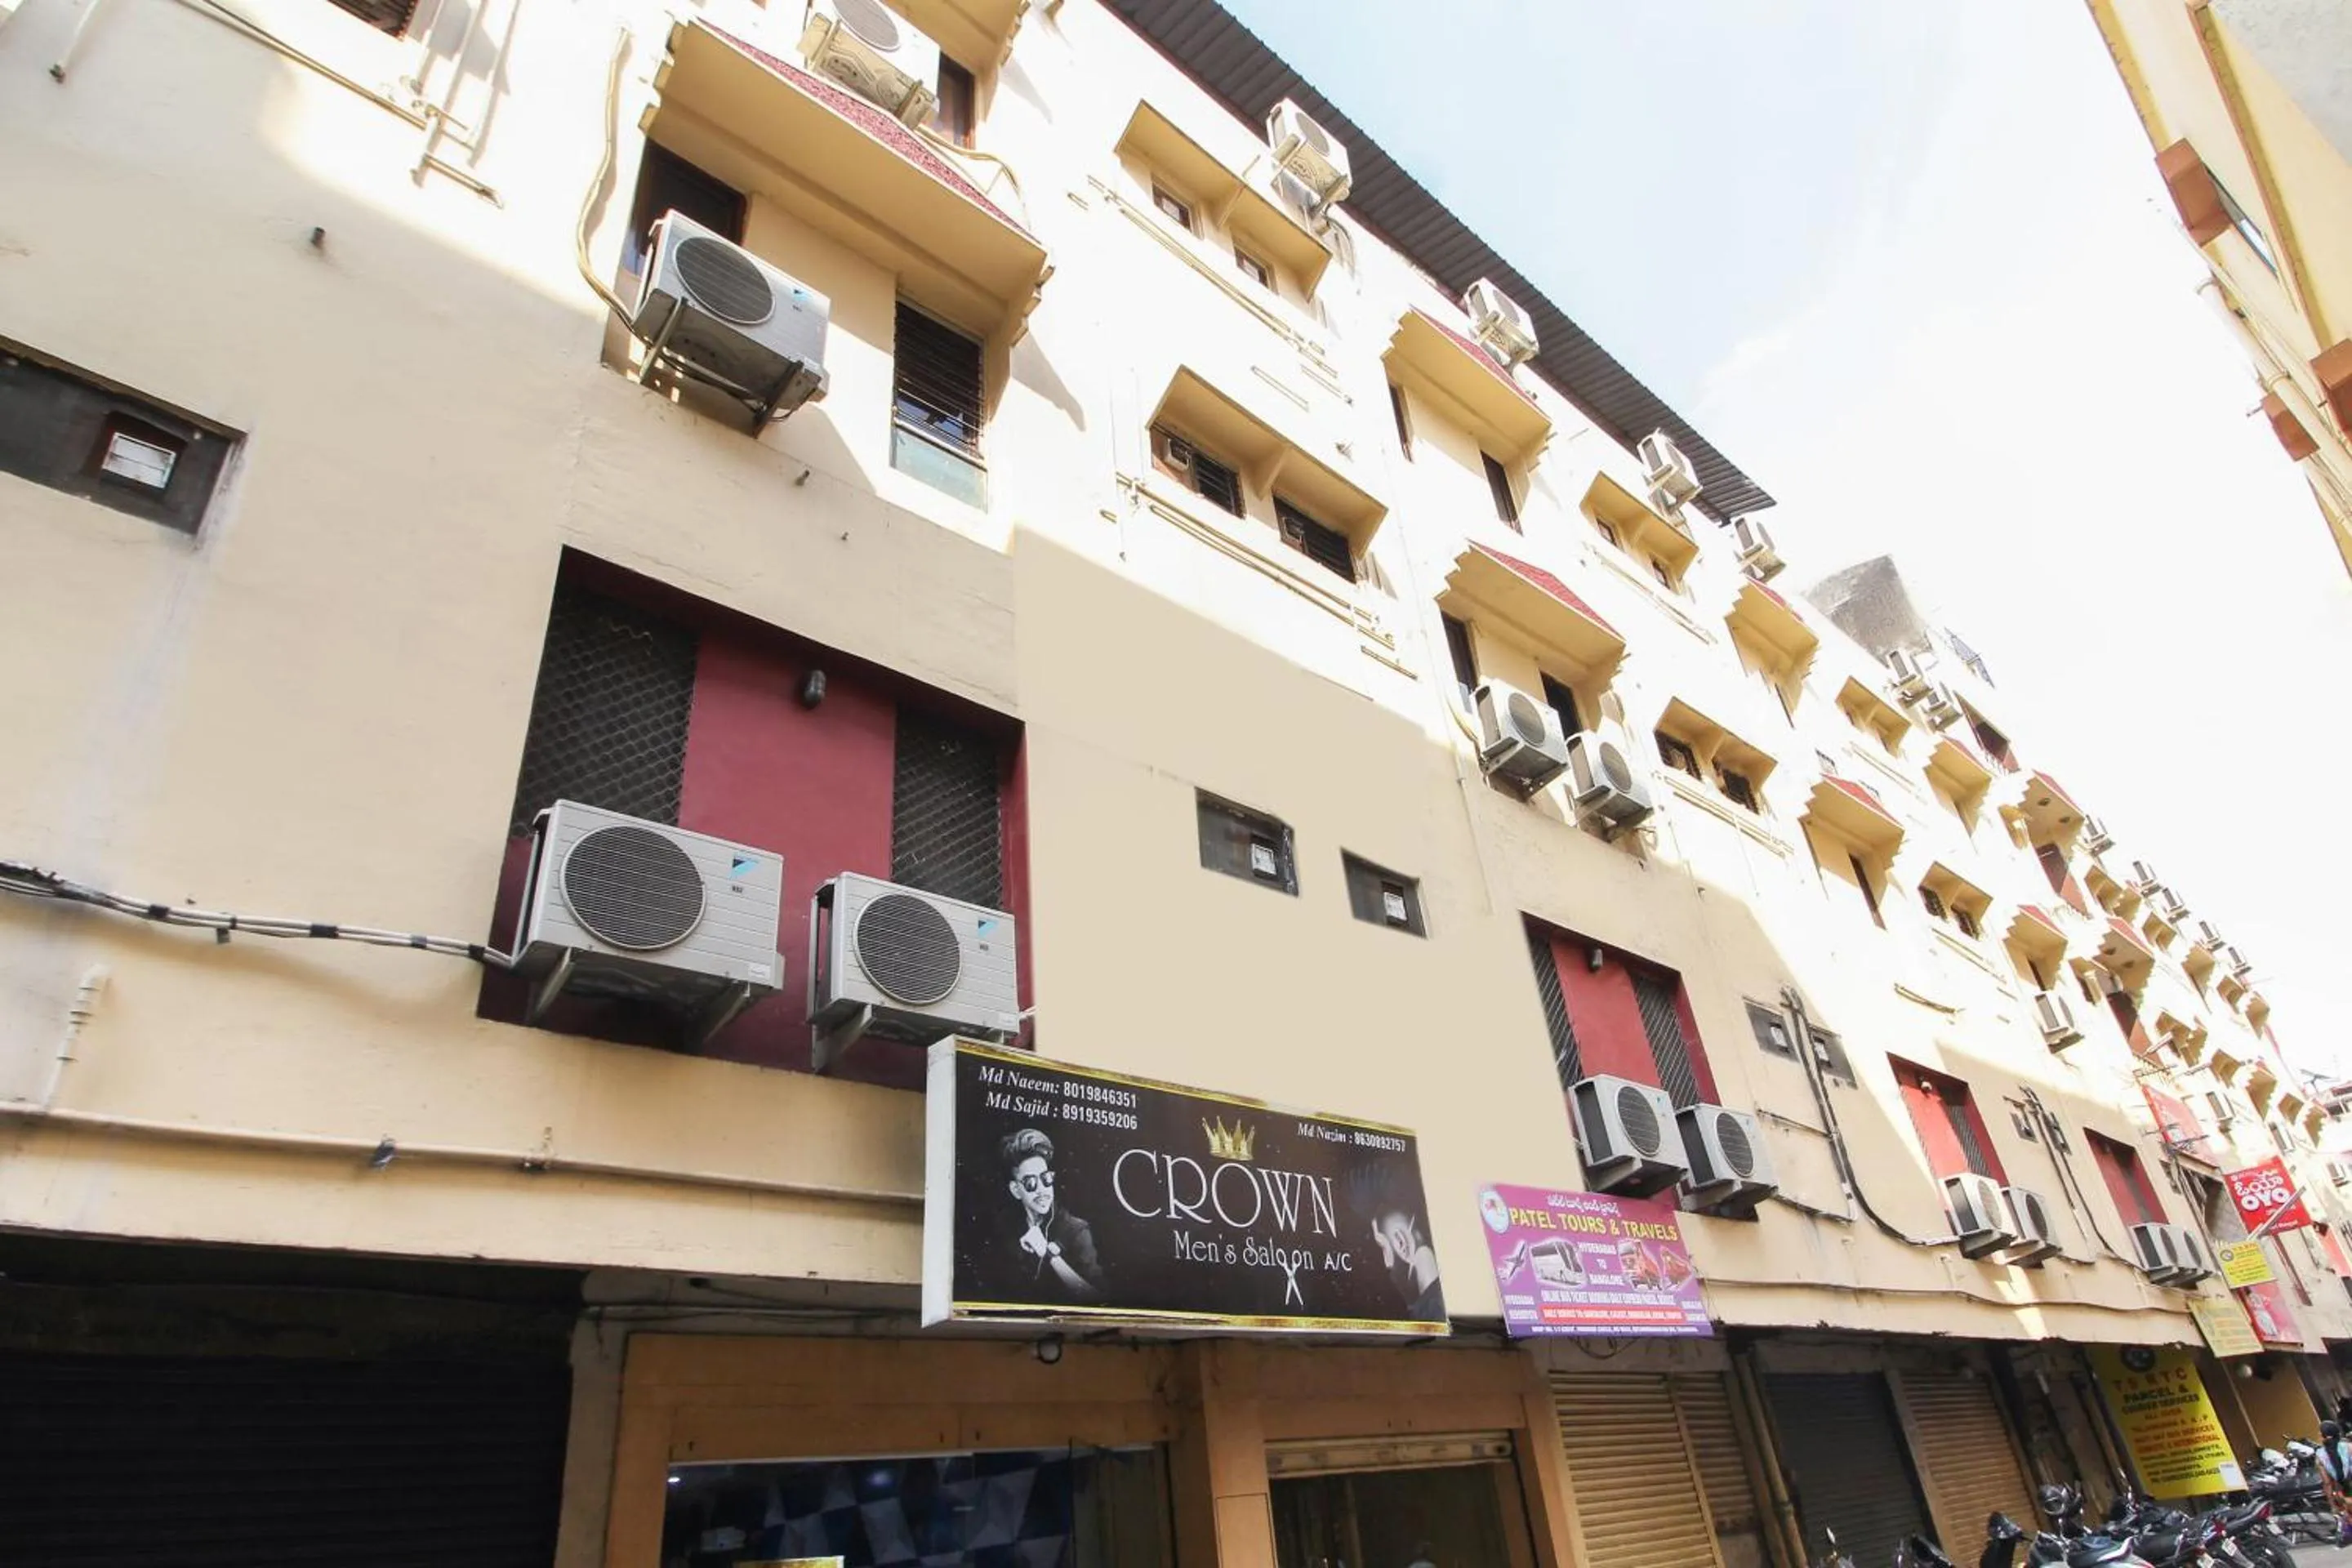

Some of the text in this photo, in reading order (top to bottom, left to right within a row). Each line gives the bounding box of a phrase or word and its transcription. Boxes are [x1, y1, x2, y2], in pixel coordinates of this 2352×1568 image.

[978, 1066, 1004, 1083] Md
[1063, 1081, 1138, 1108] 8019846351
[986, 1091, 1010, 1110] Md
[1013, 1097, 1051, 1118] Sajid
[1062, 1103, 1138, 1130] 8919359206
[1298, 1122, 1315, 1138] Md
[1112, 1148, 1338, 1239] CROWN
[2241, 1187, 2290, 1212] OYO
[1508, 1208, 1678, 1241] PATEL TOURS & TRAVELS
[1174, 1230, 1236, 1264] Men's
[1325, 1252, 1352, 1272] A/C
